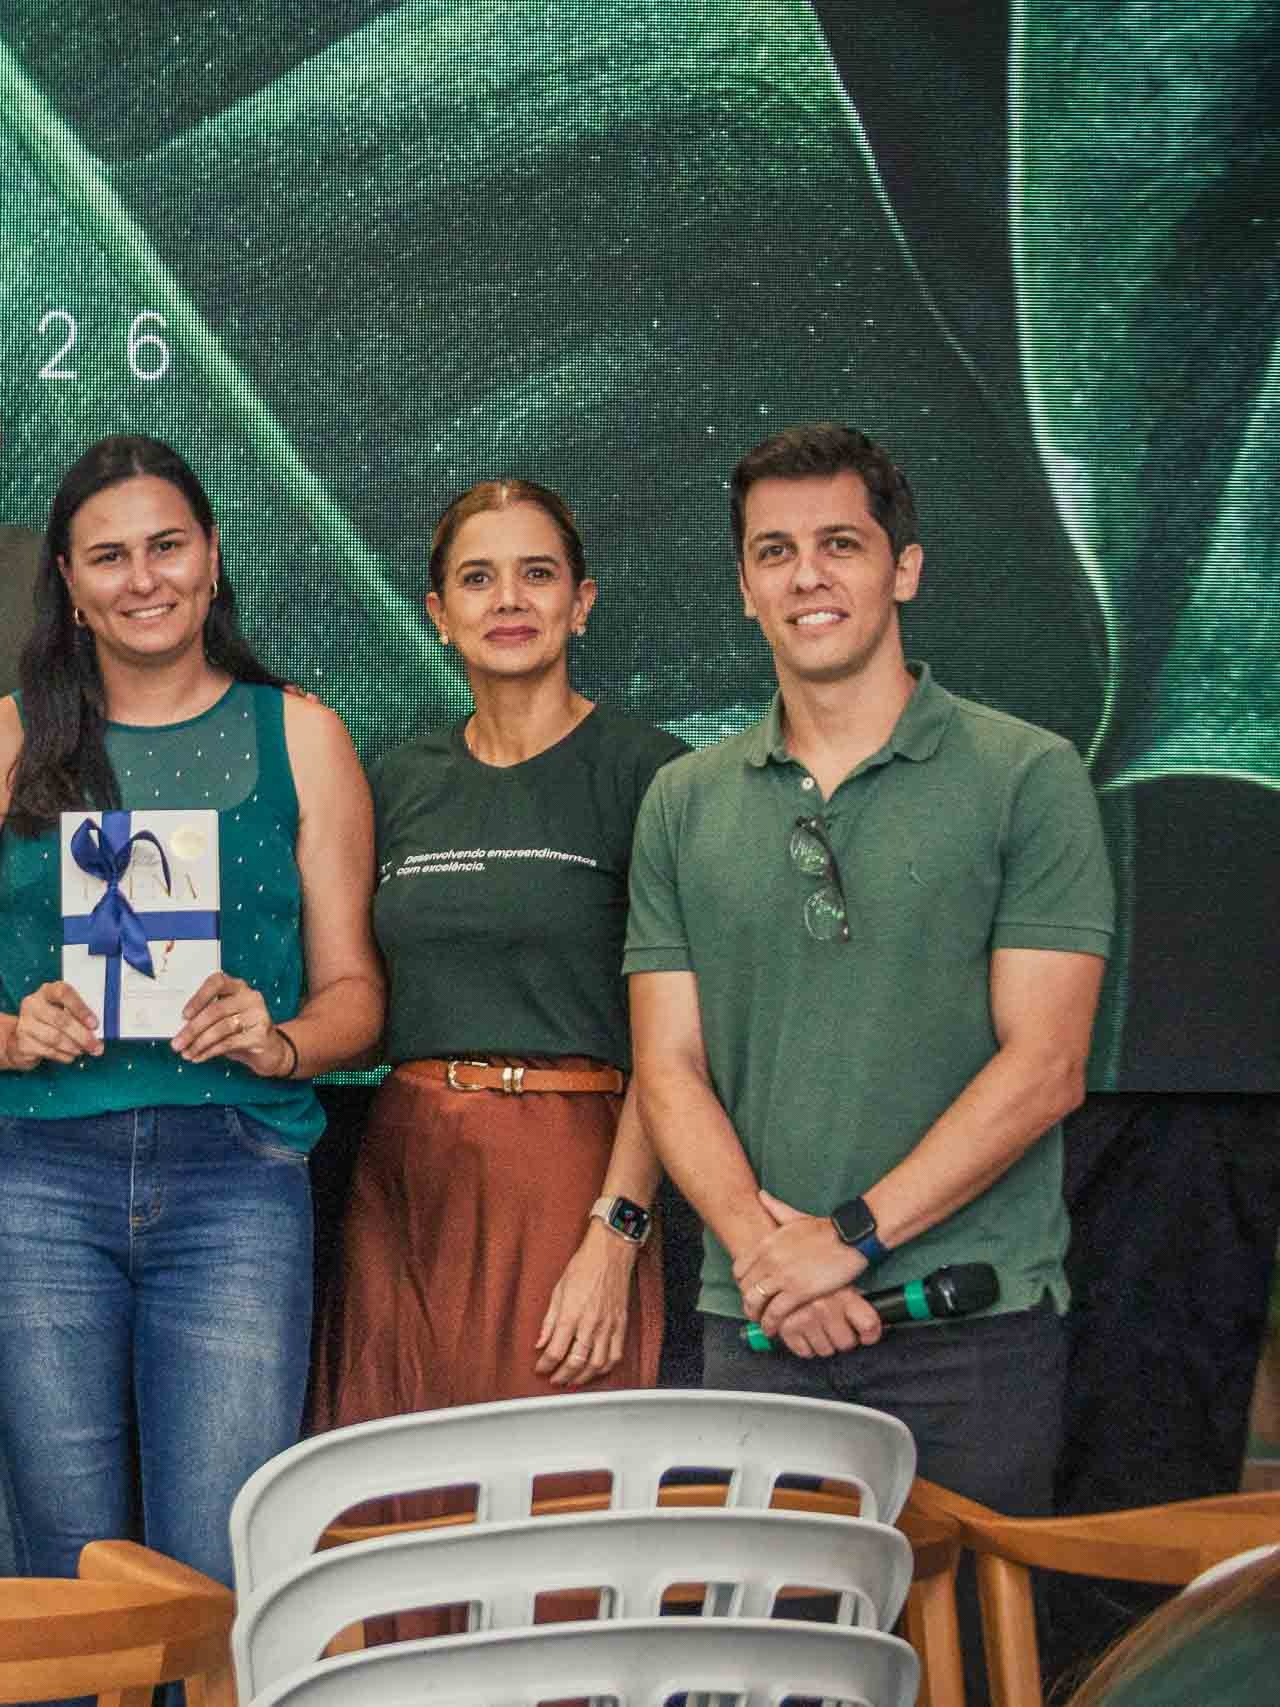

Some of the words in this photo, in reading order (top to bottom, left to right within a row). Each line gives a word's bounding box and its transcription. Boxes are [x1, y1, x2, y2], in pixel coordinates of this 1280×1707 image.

[404, 848, 486, 865] Desenvolvendo
[487, 848, 597, 867] empreendimentos
[396, 866, 421, 876] com
